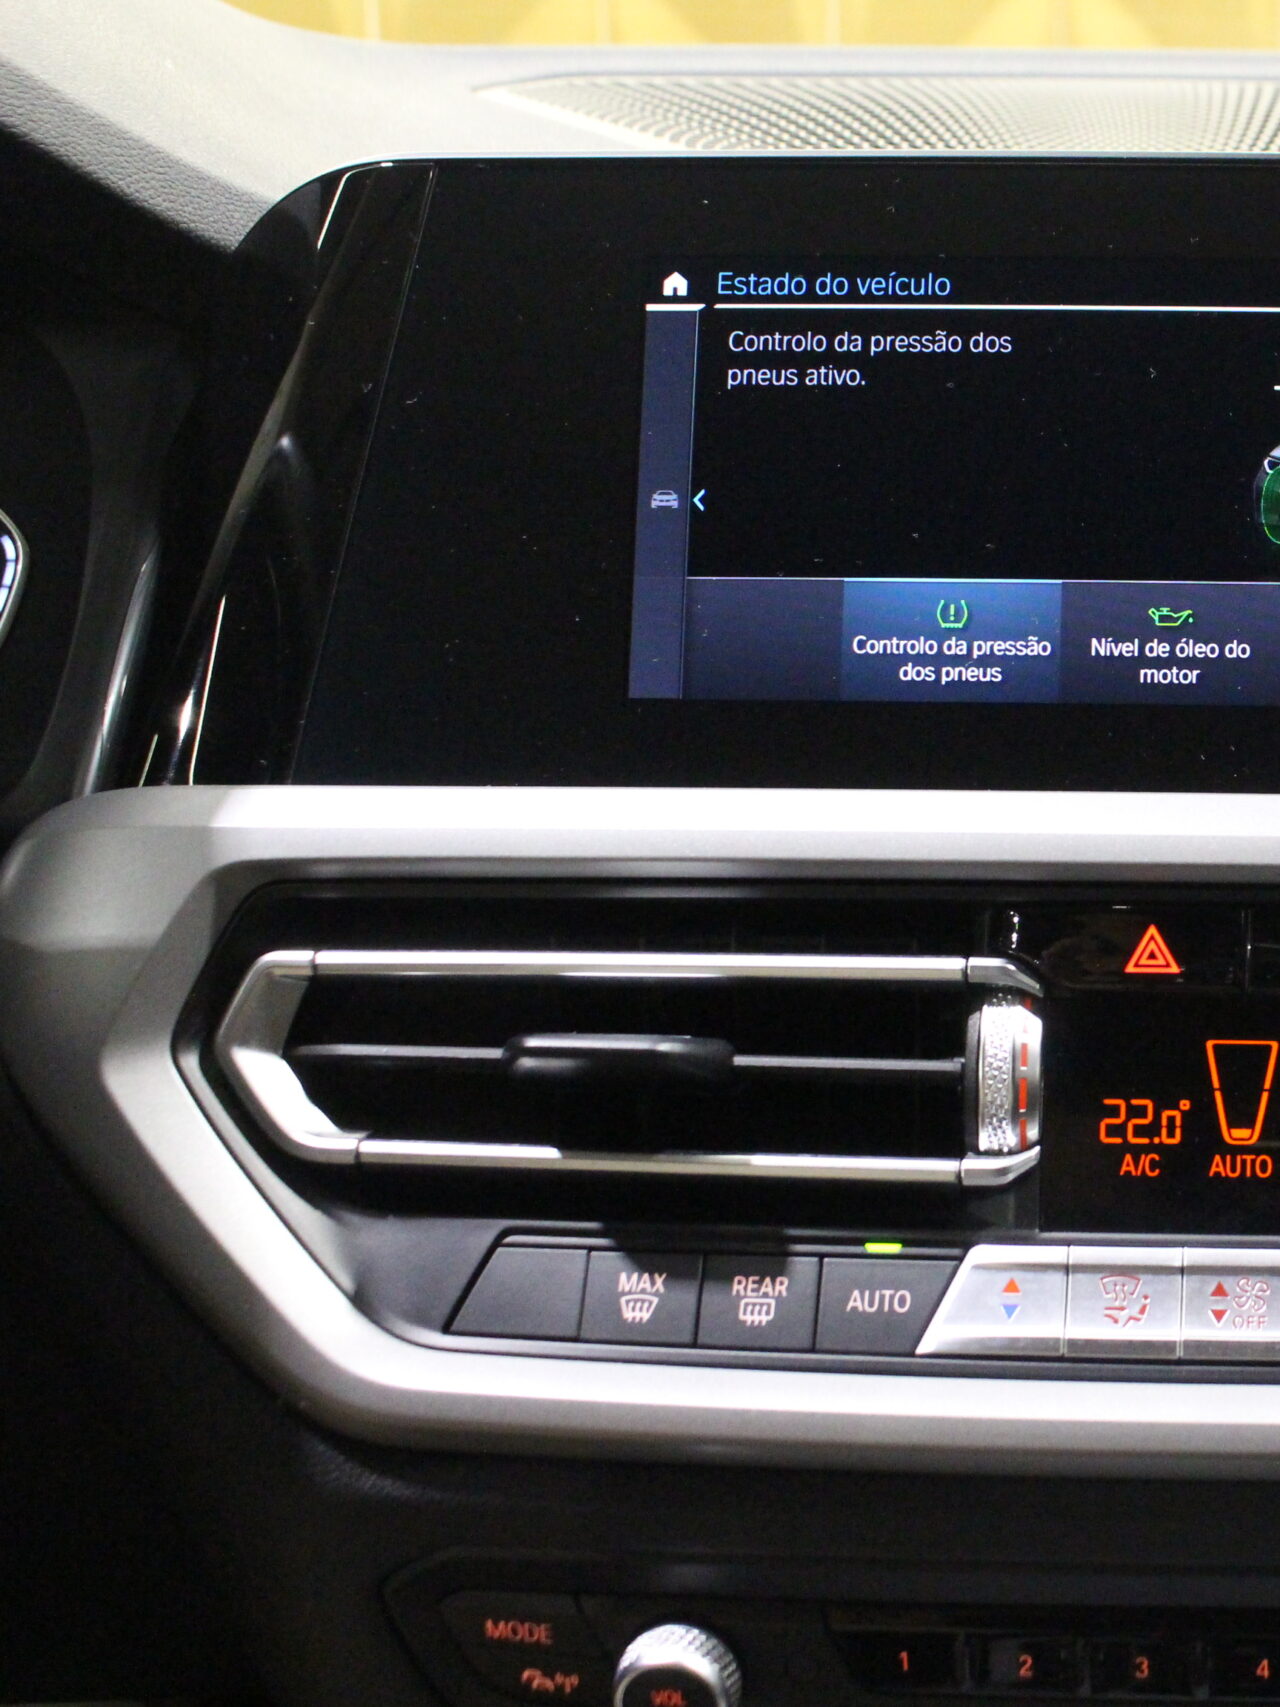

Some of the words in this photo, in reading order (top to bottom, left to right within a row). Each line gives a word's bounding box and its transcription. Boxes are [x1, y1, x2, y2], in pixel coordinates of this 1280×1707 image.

[717, 271, 807, 296] Estado
[815, 271, 848, 297] do
[857, 271, 951, 297] veículo
[728, 330, 826, 353] Controlo
[834, 331, 863, 353] da
[870, 330, 962, 356] pressão
[969, 331, 1012, 354] dos
[727, 367, 798, 389] pneus
[805, 364, 866, 387] ativo.
[852, 635, 938, 656] Controlo
[943, 636, 968, 657] da
[973, 635, 1051, 659] pressão
[1091, 637, 1139, 658] Nível
[1144, 638, 1170, 658] de
[1175, 636, 1219, 659] óleo
[1224, 640, 1251, 660] do
[899, 661, 936, 682] dos
[941, 665, 1002, 685] pneus
[1139, 665, 1200, 685] motor
[1120, 1153, 1161, 1177] A/C
[1209, 1154, 1273, 1178] AUTO
[618, 1272, 665, 1293] MAX
[732, 1276, 788, 1298] REAR
[846, 1290, 911, 1314] AUTO
[1232, 1315, 1267, 1330] OFF
[486, 1618, 552, 1644] MODE
[900, 1651, 909, 1672] 1
[1018, 1656, 1034, 1676] 2
[1134, 1656, 1149, 1679] 3
[1255, 1658, 1270, 1680] 4
